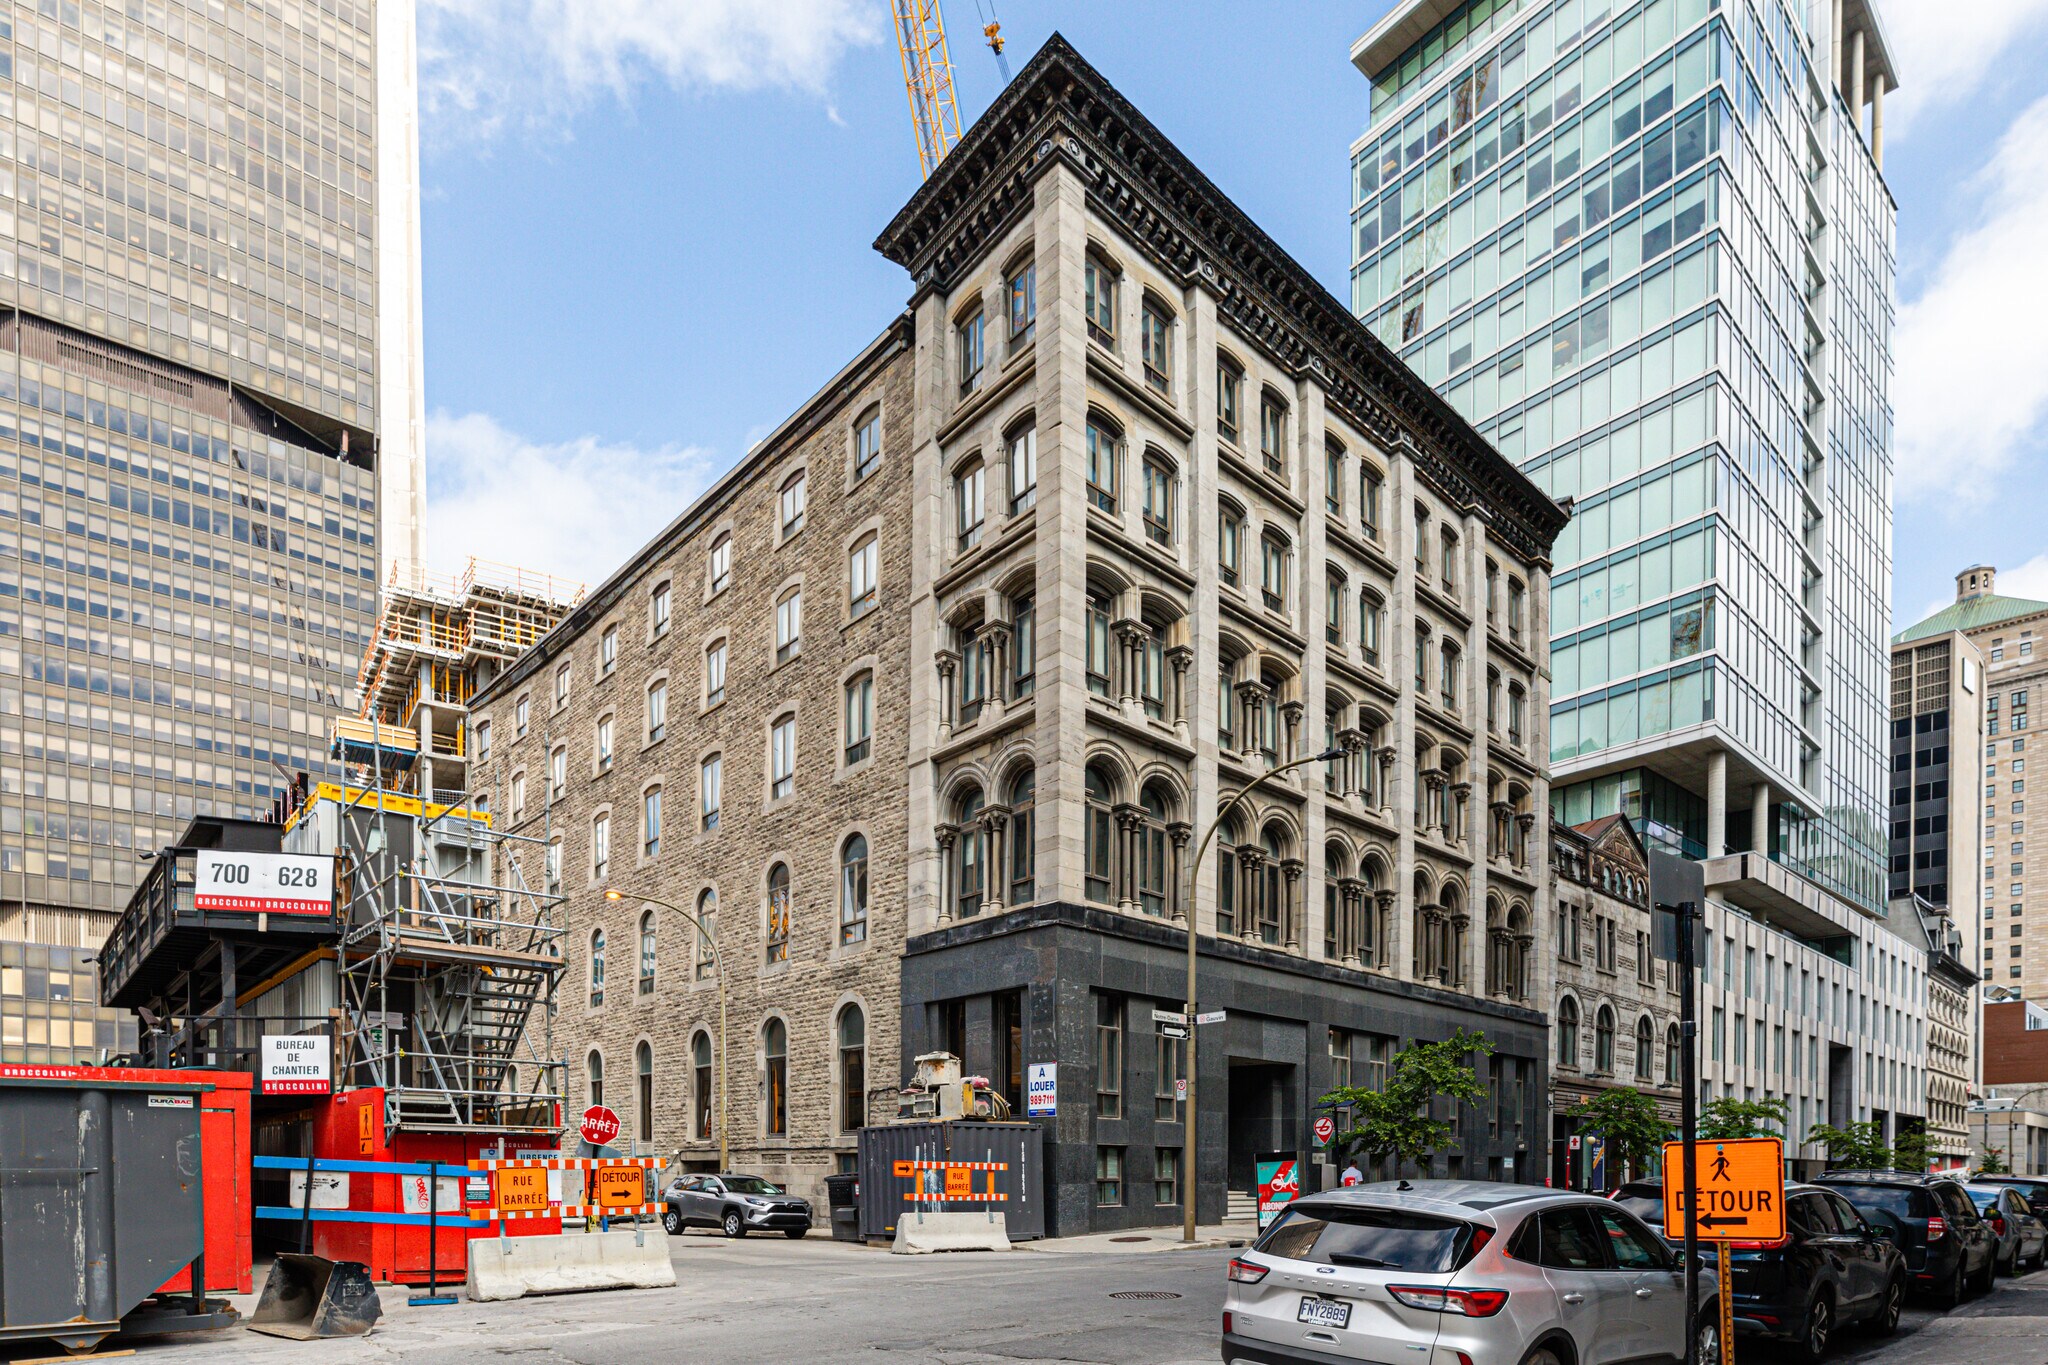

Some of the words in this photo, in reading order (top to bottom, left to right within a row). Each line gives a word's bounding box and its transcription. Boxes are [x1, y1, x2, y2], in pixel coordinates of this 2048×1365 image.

[211, 863, 250, 884] 700
[278, 866, 317, 887] 628
[197, 897, 260, 908] BROCCOLINI
[265, 900, 328, 911] BROCCOLINI
[1206, 1014, 1224, 1022] Gauvin
[276, 1040, 315, 1050] BUREAU
[287, 1053, 300, 1062] DE
[4, 1068, 72, 1077] BROCCOLINI
[272, 1065, 320, 1075] CHANTIER
[265, 1082, 327, 1091] BROCCOLINI
[1030, 1081, 1055, 1091] LOUER
[1030, 1095, 1055, 1105] 989-7111
[581, 1116, 618, 1134] ARRÊT
[513, 1176, 533, 1186] RUE
[602, 1170, 640, 1183] DÉTOUR
[952, 1172, 964, 1180] RUE
[947, 1182, 969, 1191] BARRÉE
[504, 1192, 543, 1205] BARRÉE
[1300, 1303, 1346, 1322] FNY2889
